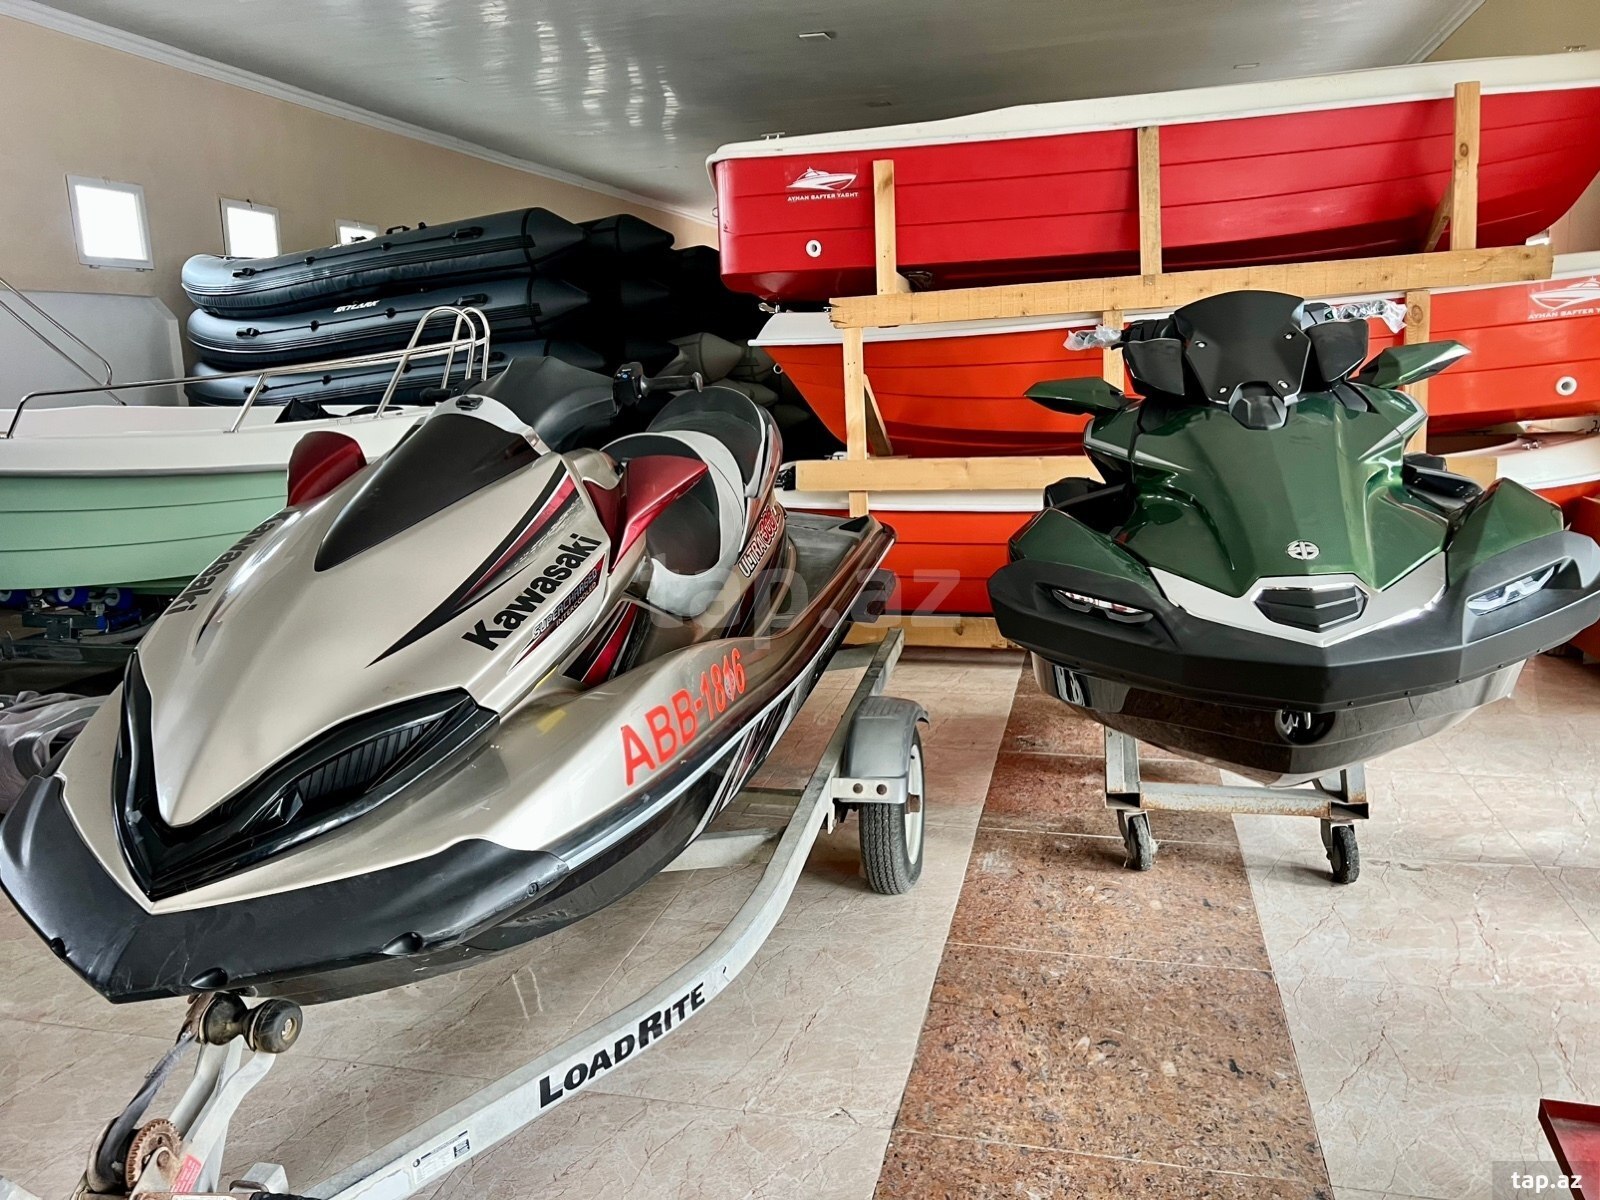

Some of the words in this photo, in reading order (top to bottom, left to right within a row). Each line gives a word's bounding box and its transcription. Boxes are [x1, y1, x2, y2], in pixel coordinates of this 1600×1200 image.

[461, 533, 602, 651] Kawasaki
[533, 568, 598, 639] SUPERCHARGED
[556, 582, 597, 627] INTERCOOLED
[620, 648, 746, 786] ABB-1816
